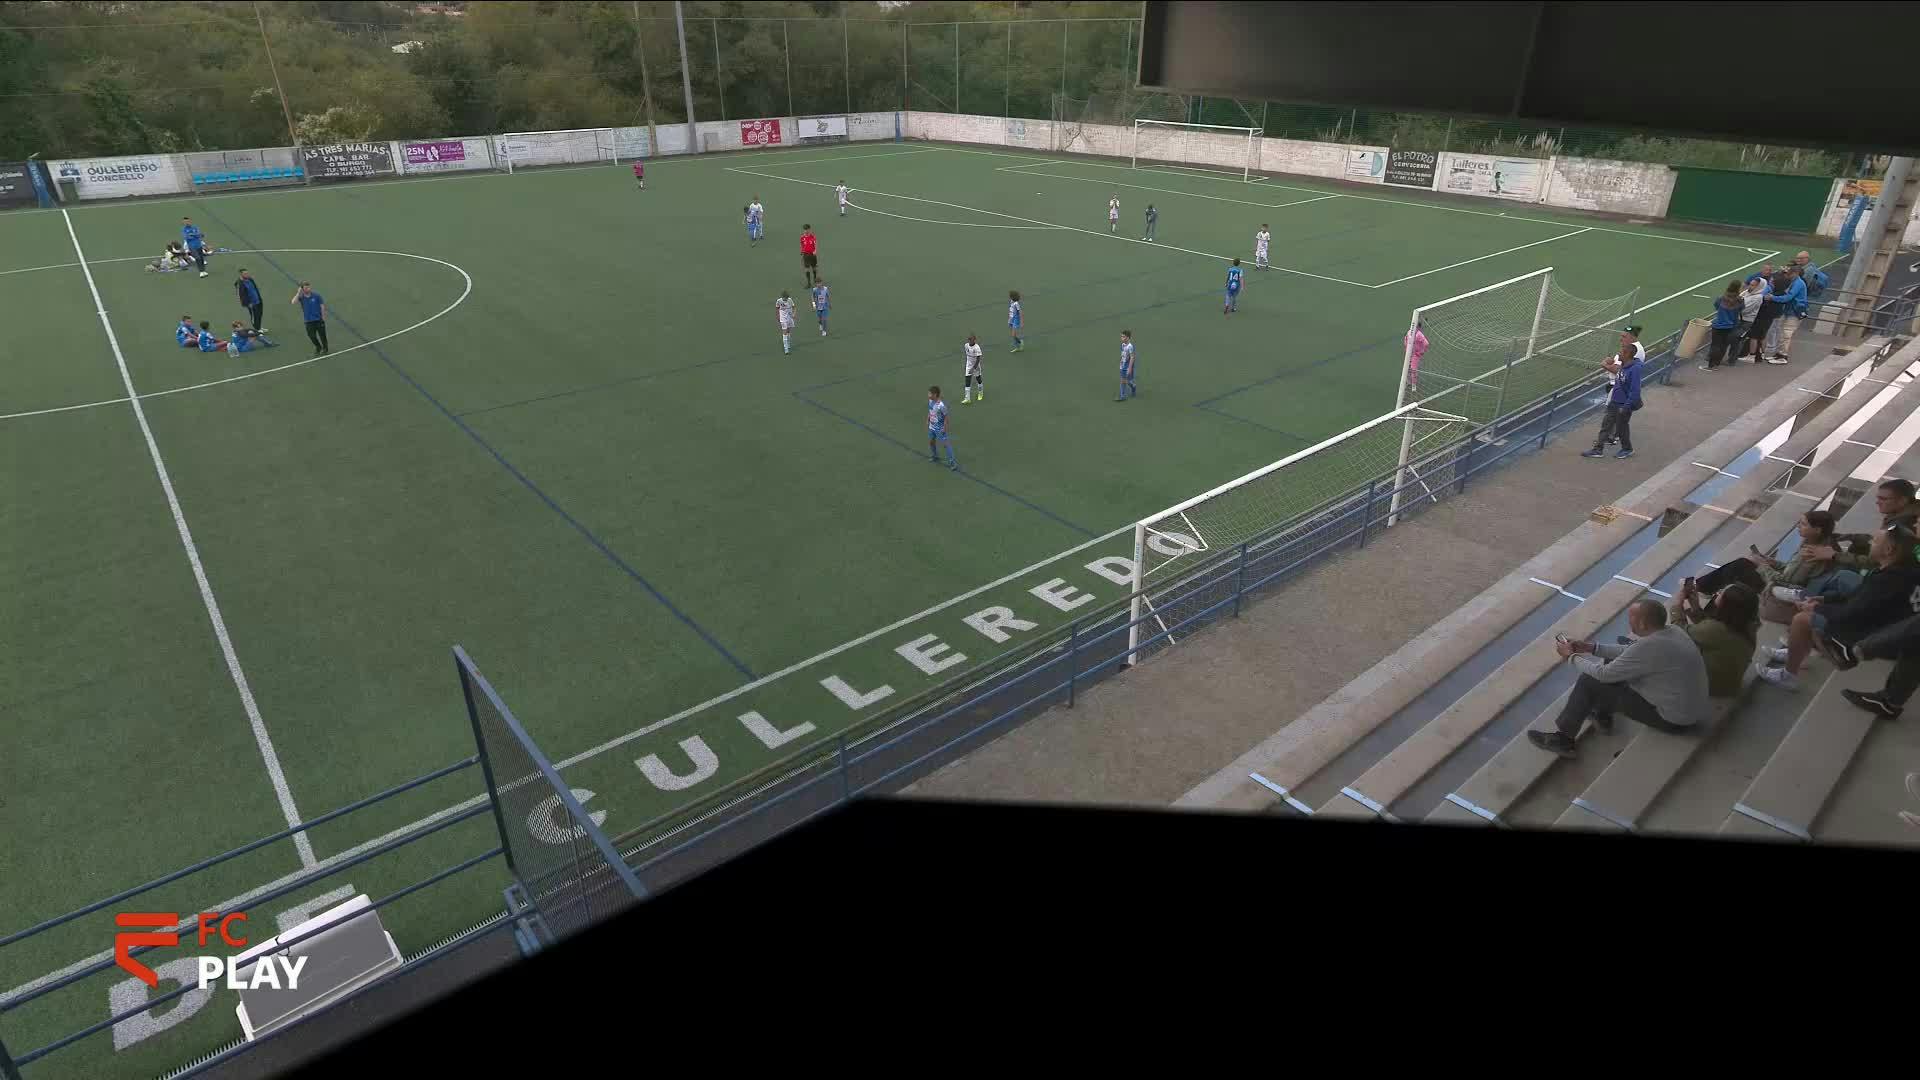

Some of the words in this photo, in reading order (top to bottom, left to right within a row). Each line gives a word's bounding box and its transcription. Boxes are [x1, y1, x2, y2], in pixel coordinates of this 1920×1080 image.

[319, 145, 343, 156] TRES
[346, 144, 386, 155] MARIAS
[407, 147, 424, 156] 25N
[1392, 152, 1402, 161] EL
[1404, 151, 1434, 164] POTRO
[90, 173, 144, 182] CONCELLO
[1230, 272, 1239, 281] 14
[527, 531, 1200, 844] CULLEREDO
